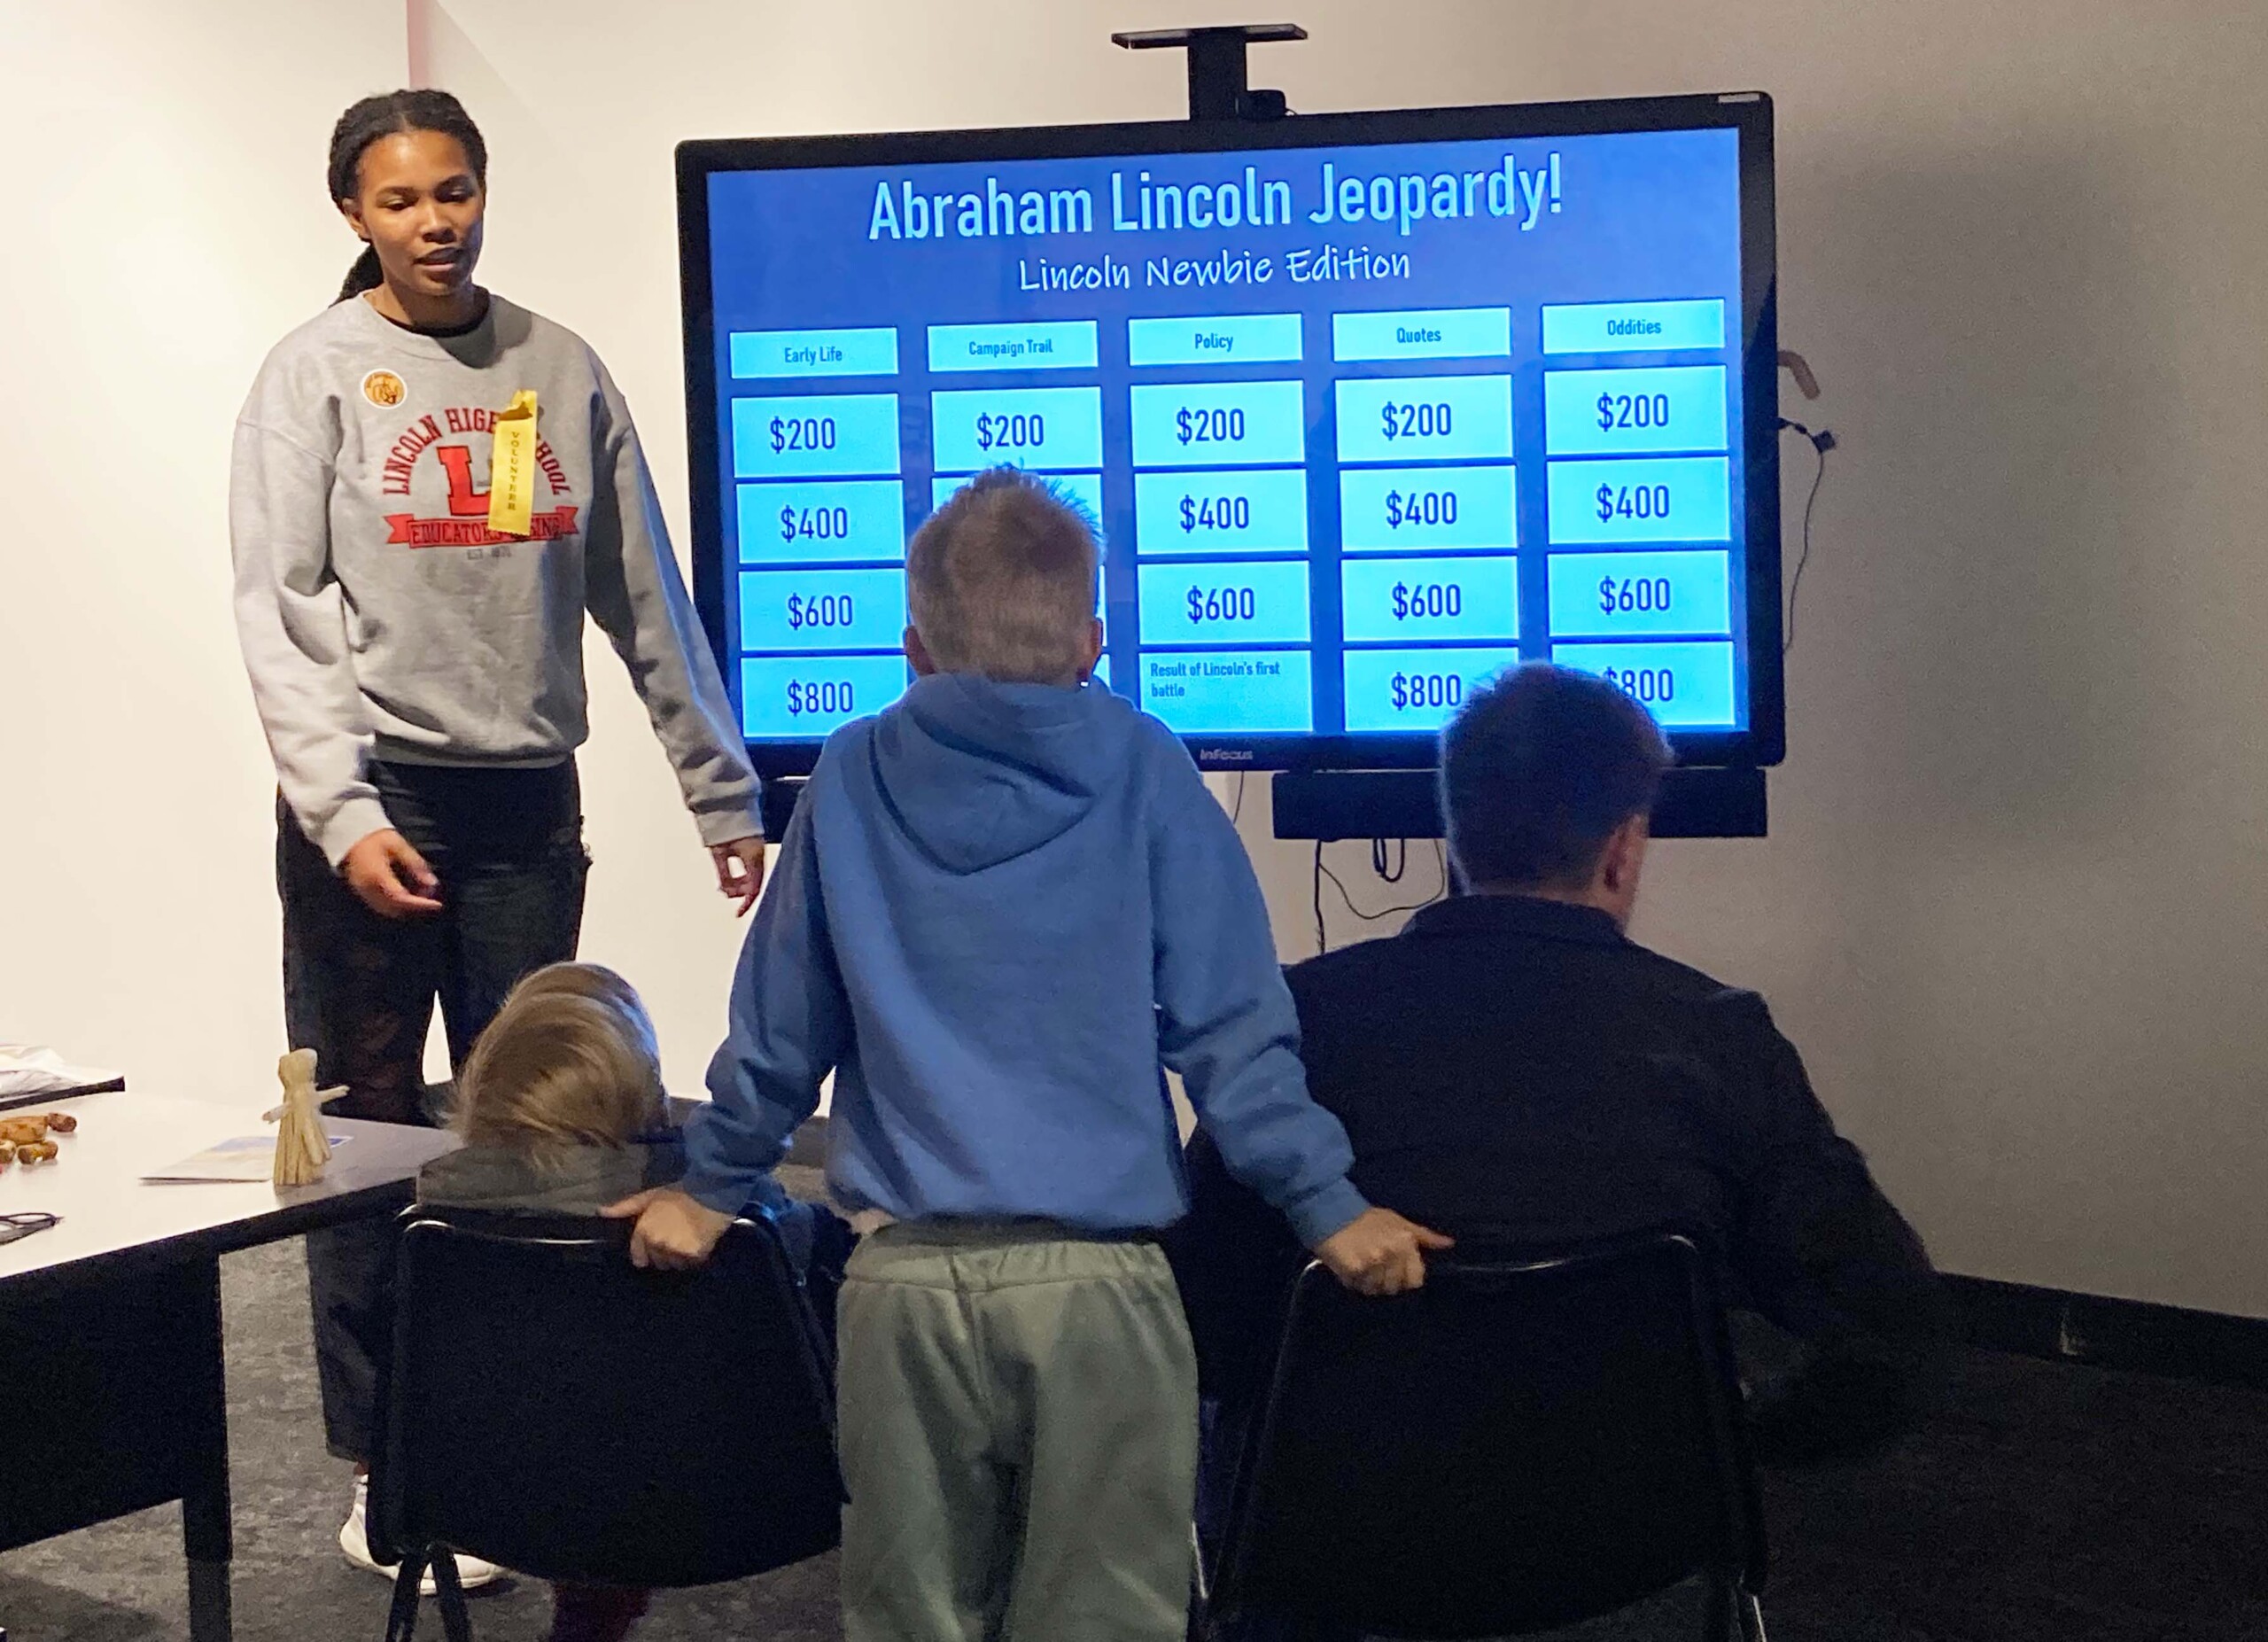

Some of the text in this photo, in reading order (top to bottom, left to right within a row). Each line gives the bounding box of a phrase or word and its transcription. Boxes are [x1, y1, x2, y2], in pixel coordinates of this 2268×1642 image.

[869, 152, 1562, 240] Abraham Lincoln Jeopardy!
[1018, 244, 1410, 292] Lincoln Newbie Edition
[1194, 332, 1234, 353] Policy
[1396, 327, 1442, 344] Quotes
[1606, 318, 1662, 337] Oddities
[784, 346, 843, 366] Early Life
[968, 339, 1053, 358] Campaign Trail
[977, 412, 1045, 451] $200
[1177, 407, 1245, 446] $200
[1382, 401, 1452, 441] $200
[1597, 392, 1669, 432] $200
[383, 414, 443, 496] LINCOLN
[536, 432, 572, 495] HOOL
[770, 416, 835, 455] $200
[508, 432, 521, 510] VOLUNTEER
[1180, 494, 1249, 533] $400
[1386, 490, 1457, 529] $400
[1597, 483, 1670, 523] $400
[781, 504, 848, 543] $400
[788, 592, 853, 631] $600
[1187, 585, 1254, 625] $600
[1393, 581, 1461, 621] $600
[1599, 575, 1670, 616] $600
[1150, 661, 1281, 677] Result of Lincoln's first
[788, 679, 853, 717] $800
[1151, 683, 1185, 697] battle
[1392, 672, 1462, 711] $800
